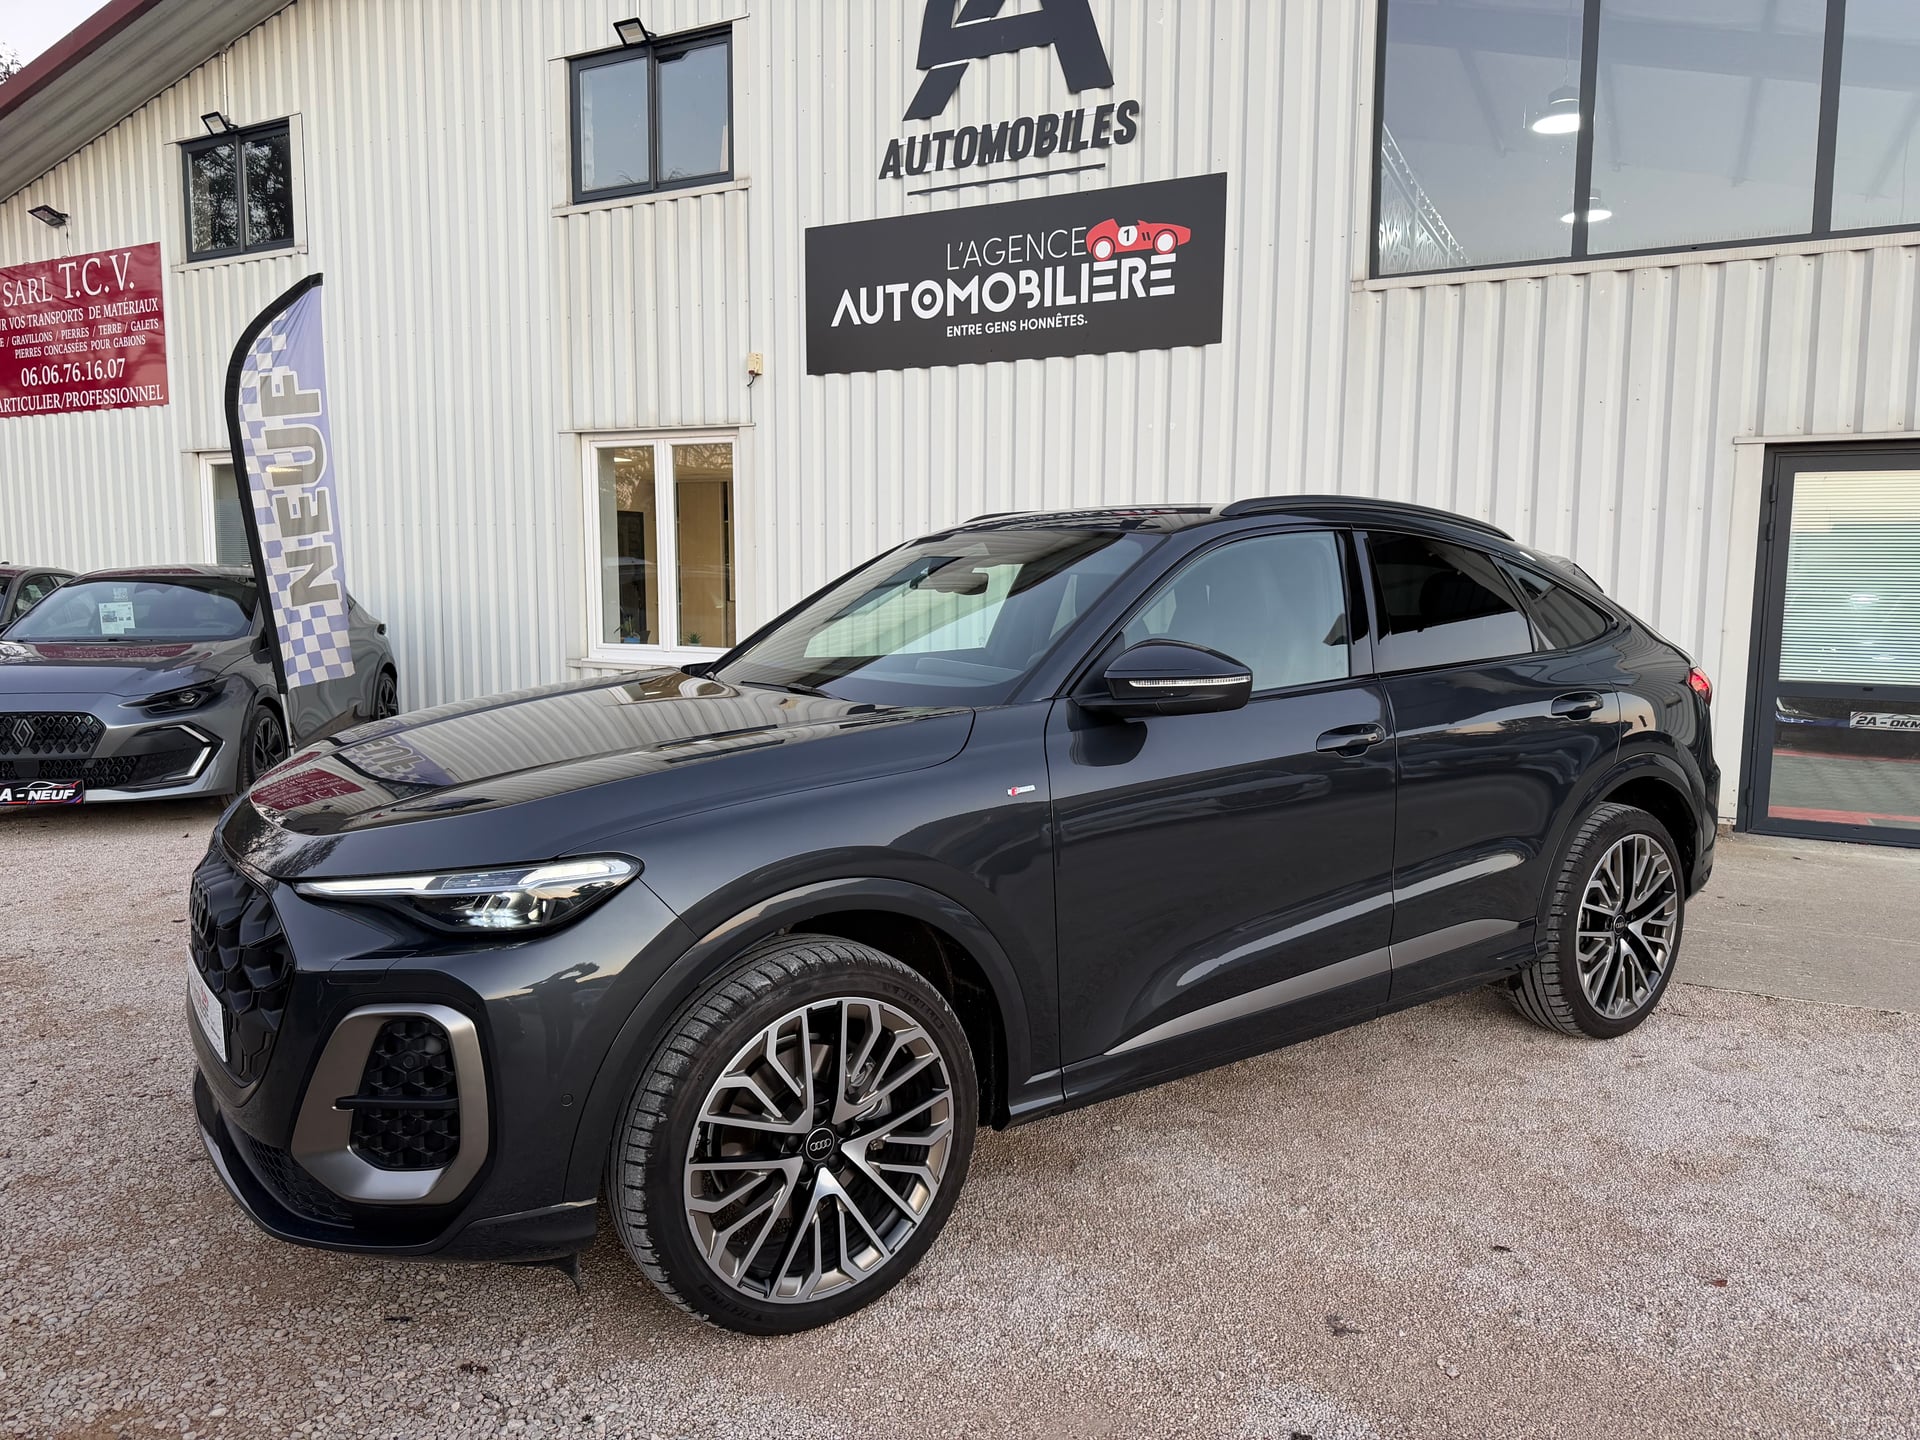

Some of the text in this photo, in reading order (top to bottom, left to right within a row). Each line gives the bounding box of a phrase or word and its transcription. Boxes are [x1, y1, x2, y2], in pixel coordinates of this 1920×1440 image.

[878, 99, 1140, 180] AUTOMOBILES
[3, 252, 135, 307] SARL T.C.V.
[9, 315, 25, 329] VOS
[27, 308, 83, 327] TRANSPORTS
[89, 306, 100, 319] DE
[104, 296, 158, 318] MATÉRIAUX
[946, 312, 1088, 338] ENTRE GENS HONNÊTES.
[12, 332, 53, 346] GRAVILLONS
[61, 327, 89, 339] PIERRES
[98, 323, 122, 335] TERRE
[131, 318, 158, 331] GALETS
[15, 335, 146, 359] PIERRES CONCASSÉES POUR GABIONS
[21, 358, 126, 387] 06.06.76.16.07
[259, 370, 344, 607] NEUF
[1856, 716, 1877, 726] 2A
[28, 789, 76, 801] NEUF
